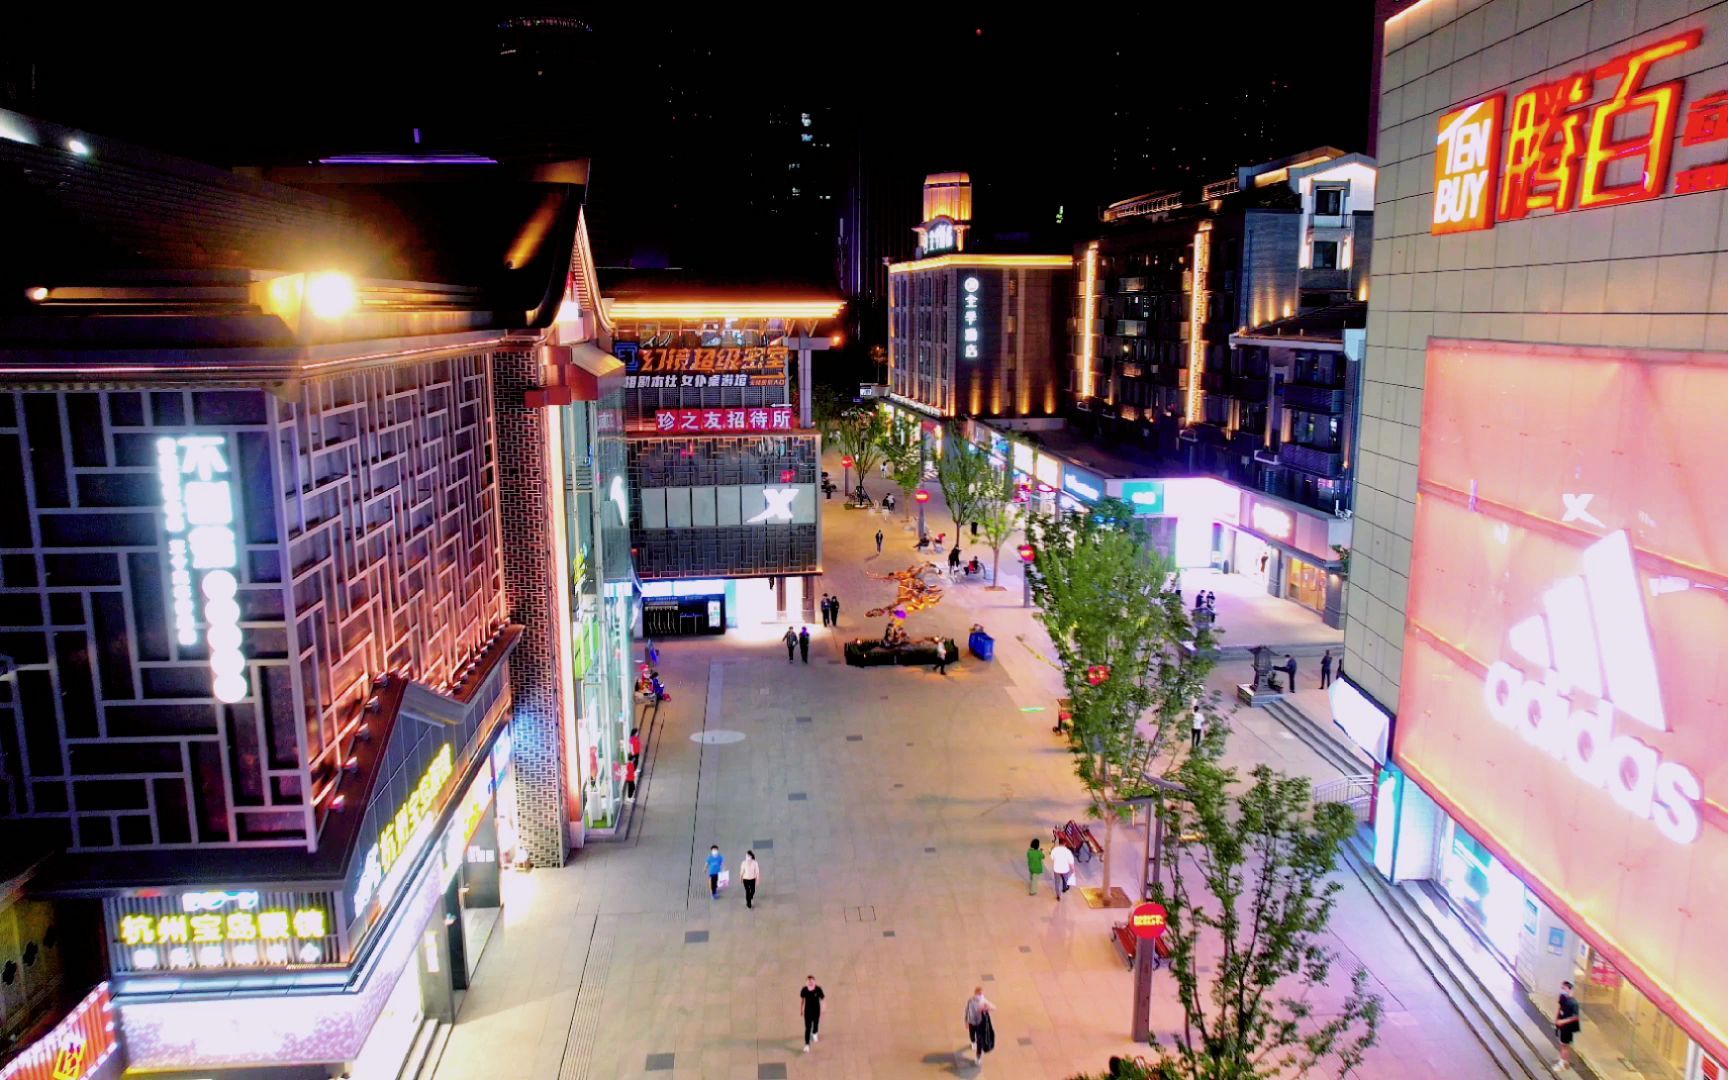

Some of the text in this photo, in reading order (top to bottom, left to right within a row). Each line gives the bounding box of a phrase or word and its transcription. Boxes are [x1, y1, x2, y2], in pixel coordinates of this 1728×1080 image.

[1437, 101, 1493, 175] TEN
[1433, 169, 1489, 224] BUY
[964, 294, 979, 359] 全季店
[656, 410, 792, 430] 珍之友招待所
[1483, 659, 1704, 844] adidas
